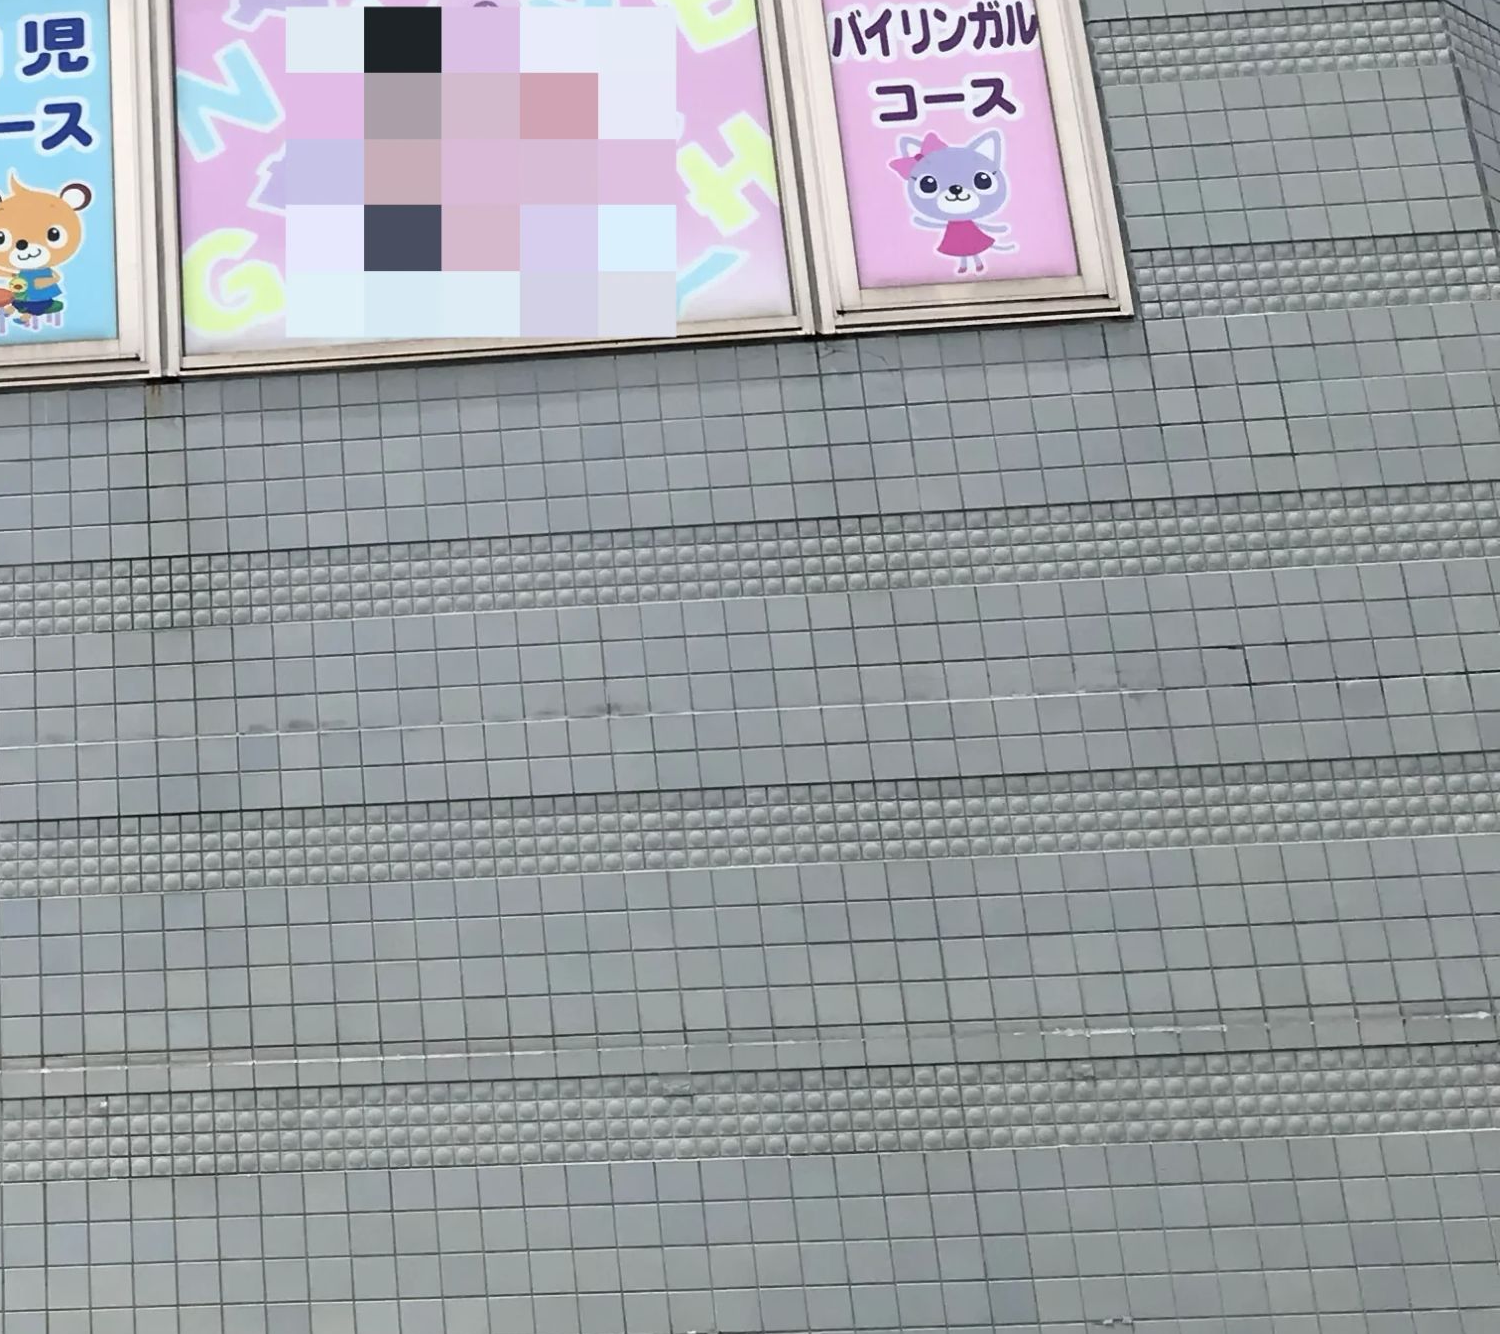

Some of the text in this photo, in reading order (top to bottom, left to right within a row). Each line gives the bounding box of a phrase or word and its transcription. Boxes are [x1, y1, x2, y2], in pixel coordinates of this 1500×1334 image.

[831, 0, 1039, 57] バイリンガル
[875, 78, 1017, 122] コース
